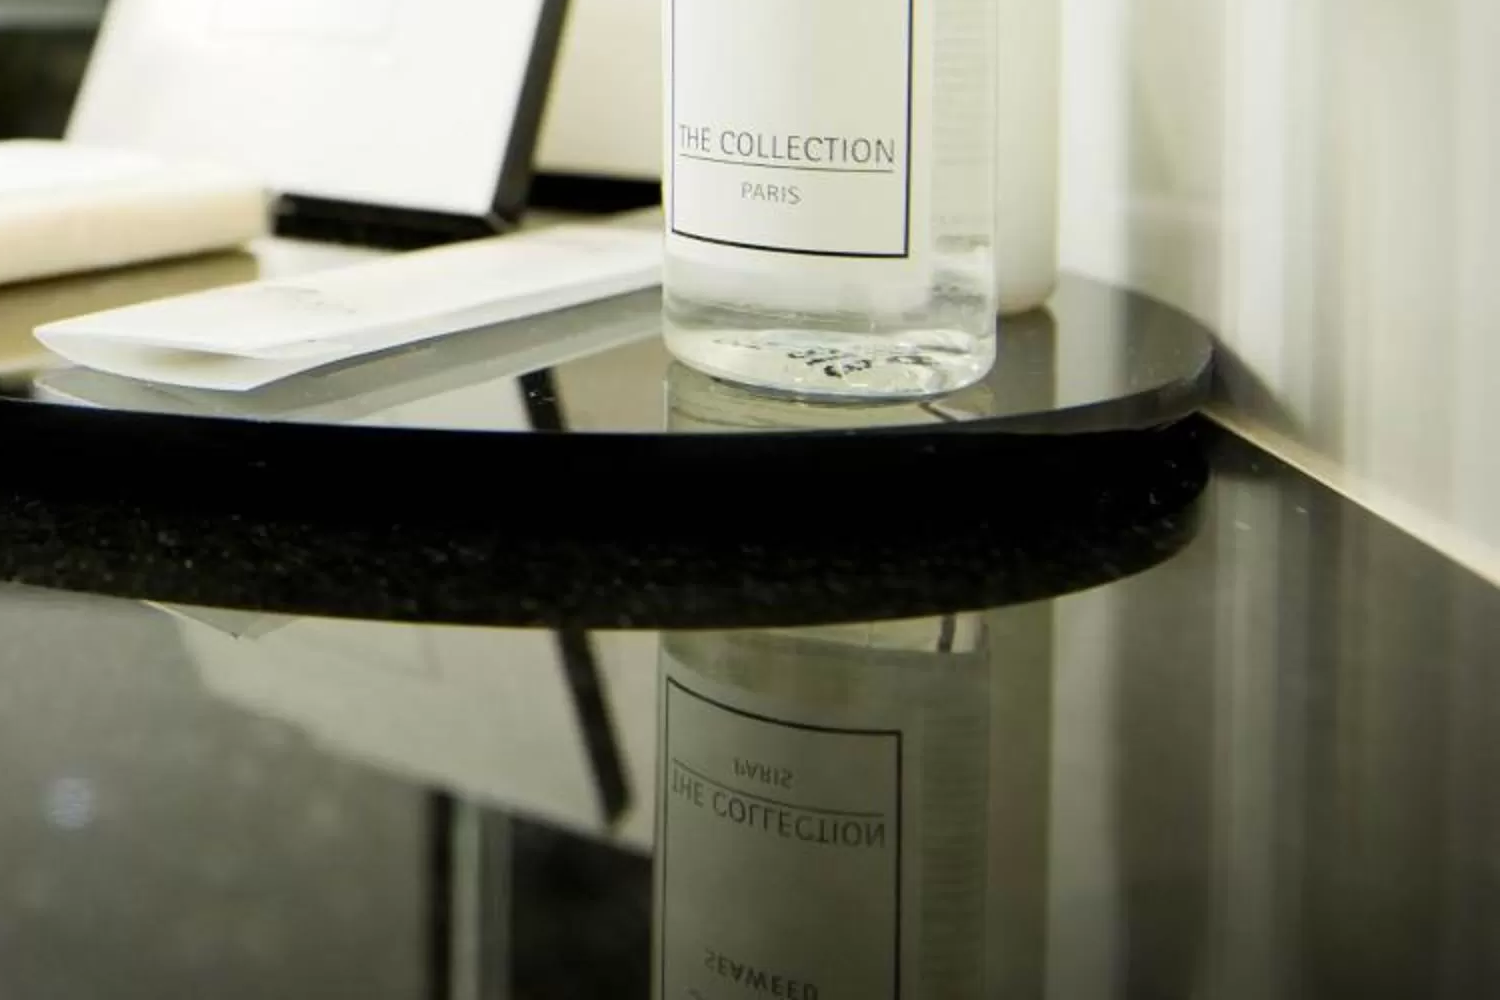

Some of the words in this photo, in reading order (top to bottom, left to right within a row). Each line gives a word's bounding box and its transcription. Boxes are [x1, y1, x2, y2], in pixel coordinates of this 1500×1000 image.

[679, 124, 712, 153] THE
[719, 129, 896, 165] COLLECTION
[740, 181, 802, 206] PARIS
